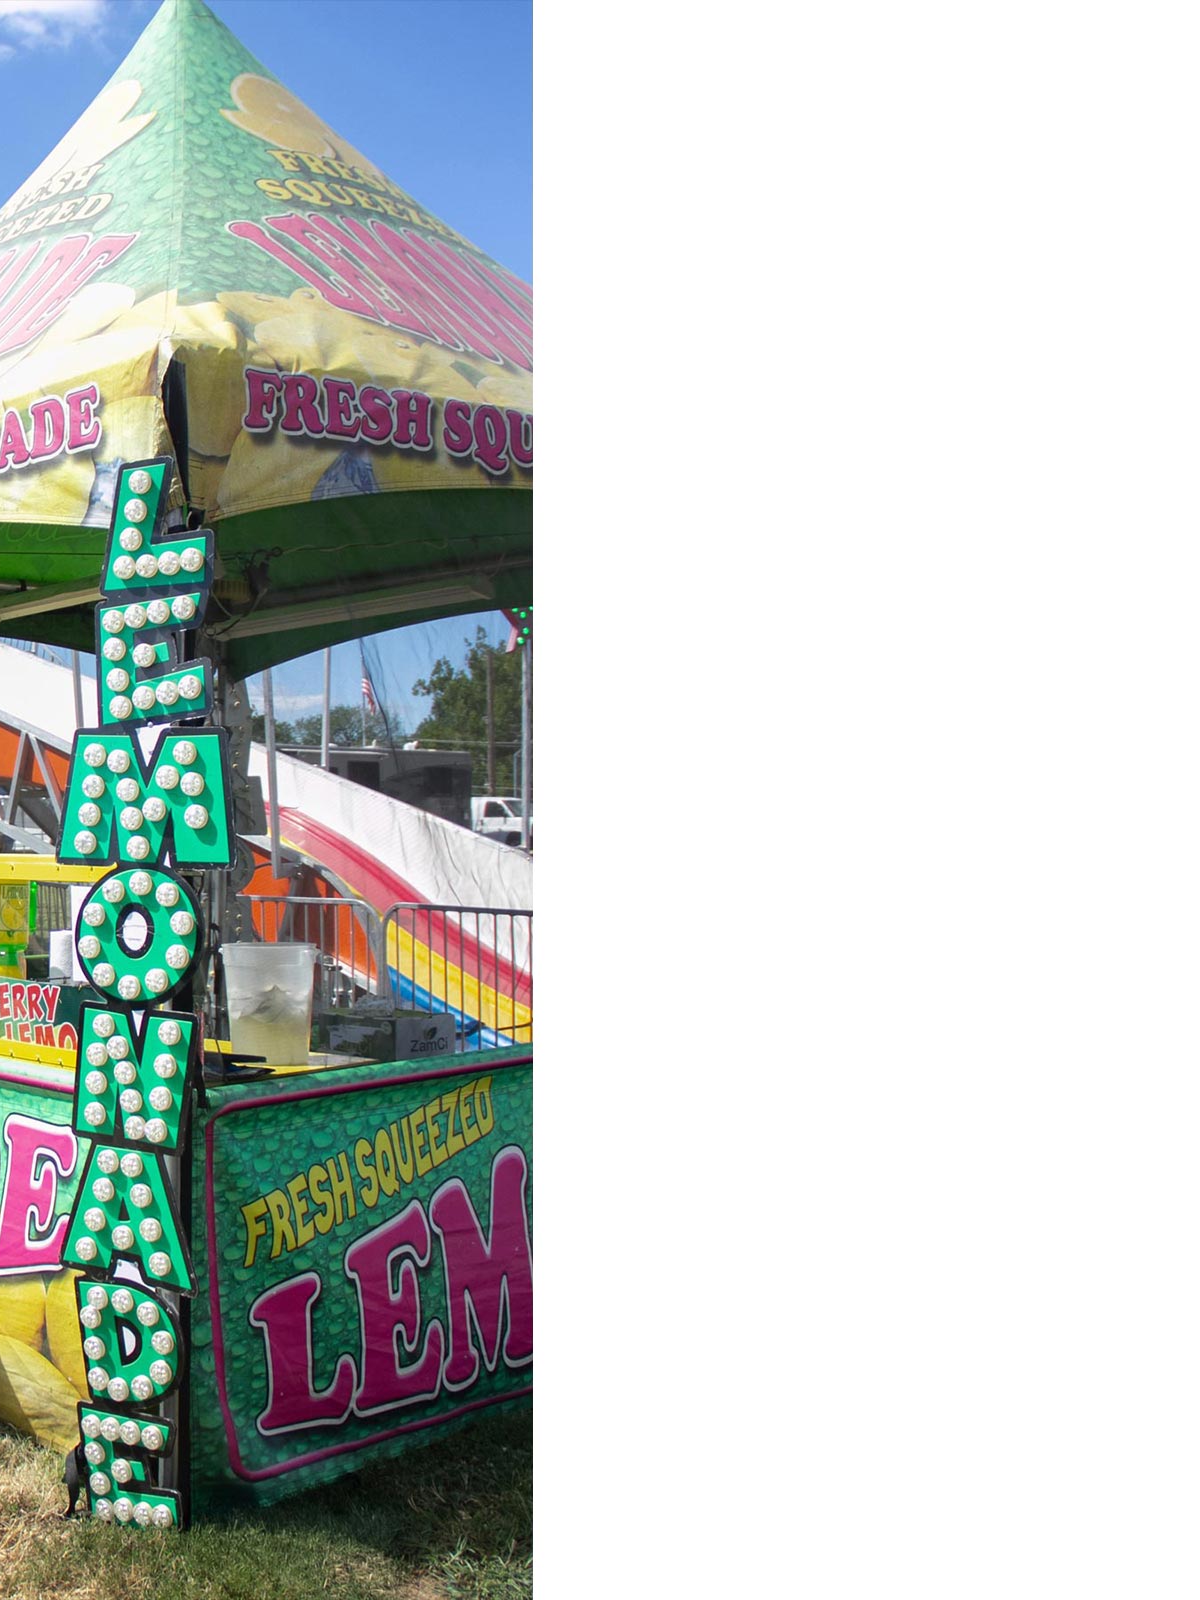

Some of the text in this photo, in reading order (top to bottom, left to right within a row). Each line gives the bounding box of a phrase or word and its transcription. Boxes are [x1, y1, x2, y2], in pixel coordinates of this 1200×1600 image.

[242, 366, 533, 474] FRESH SQU
[57, 455, 237, 1531] LEMONADE
[409, 1036, 450, 1053] ZamCi
[240, 1076, 495, 1268] FRESH SQUEEZED
[248, 1143, 533, 1437] LEM
